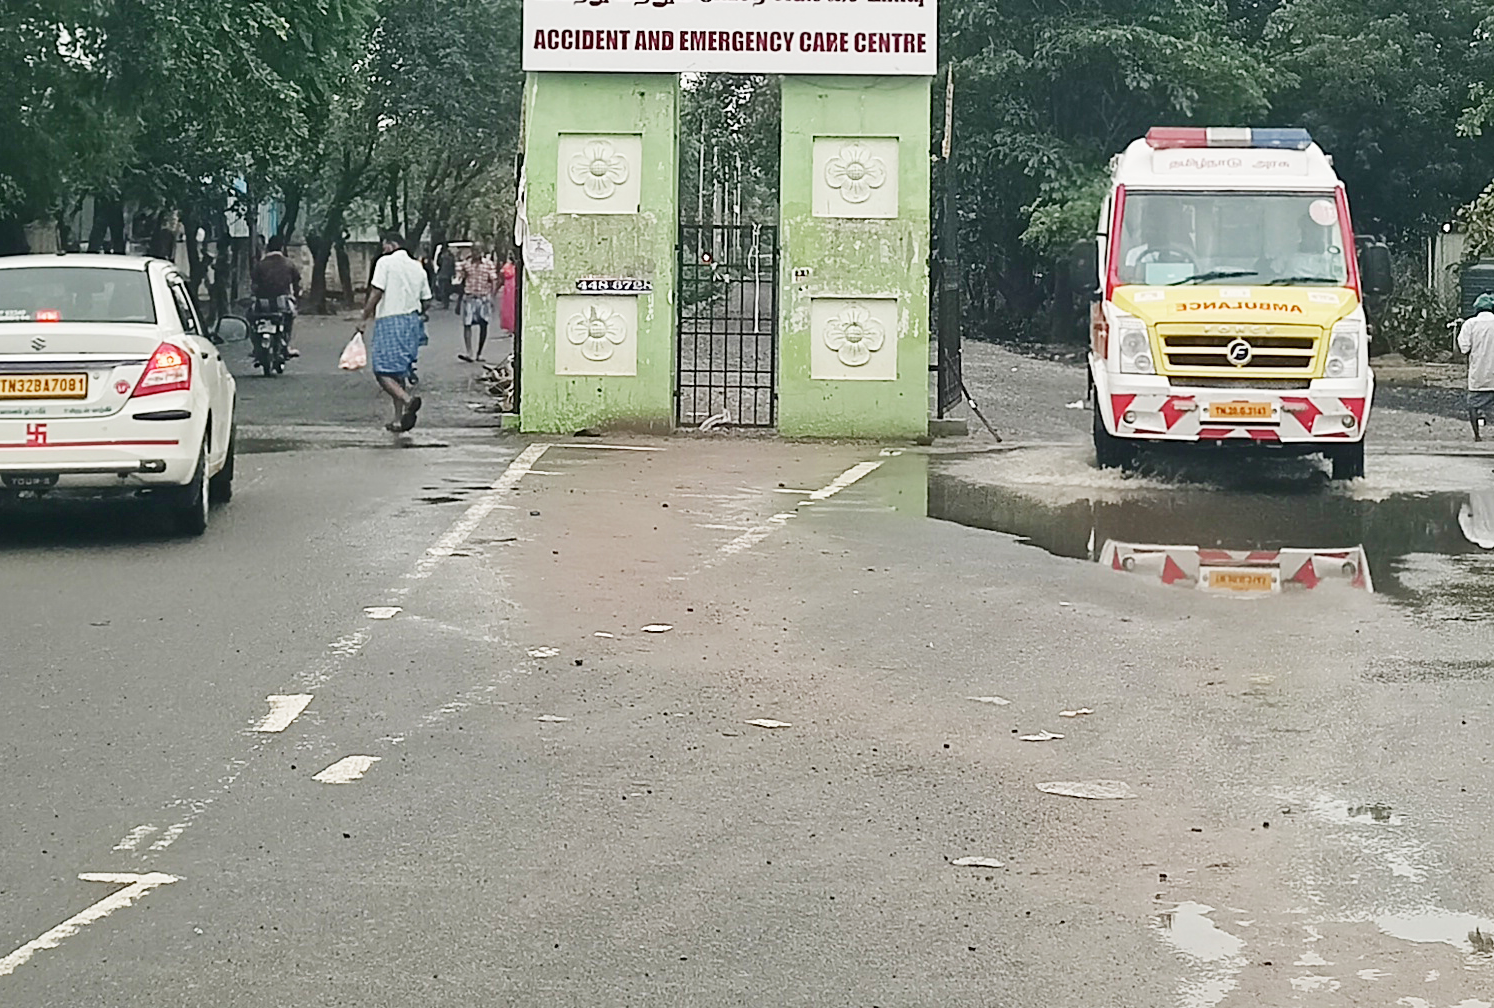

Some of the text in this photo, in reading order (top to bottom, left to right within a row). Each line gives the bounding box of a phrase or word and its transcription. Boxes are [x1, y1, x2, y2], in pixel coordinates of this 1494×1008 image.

[533, 29, 927, 53] ACCIDENT AND EMERGENCY CARE CENTRE
[0, 378, 84, 393] TN32BA7081
